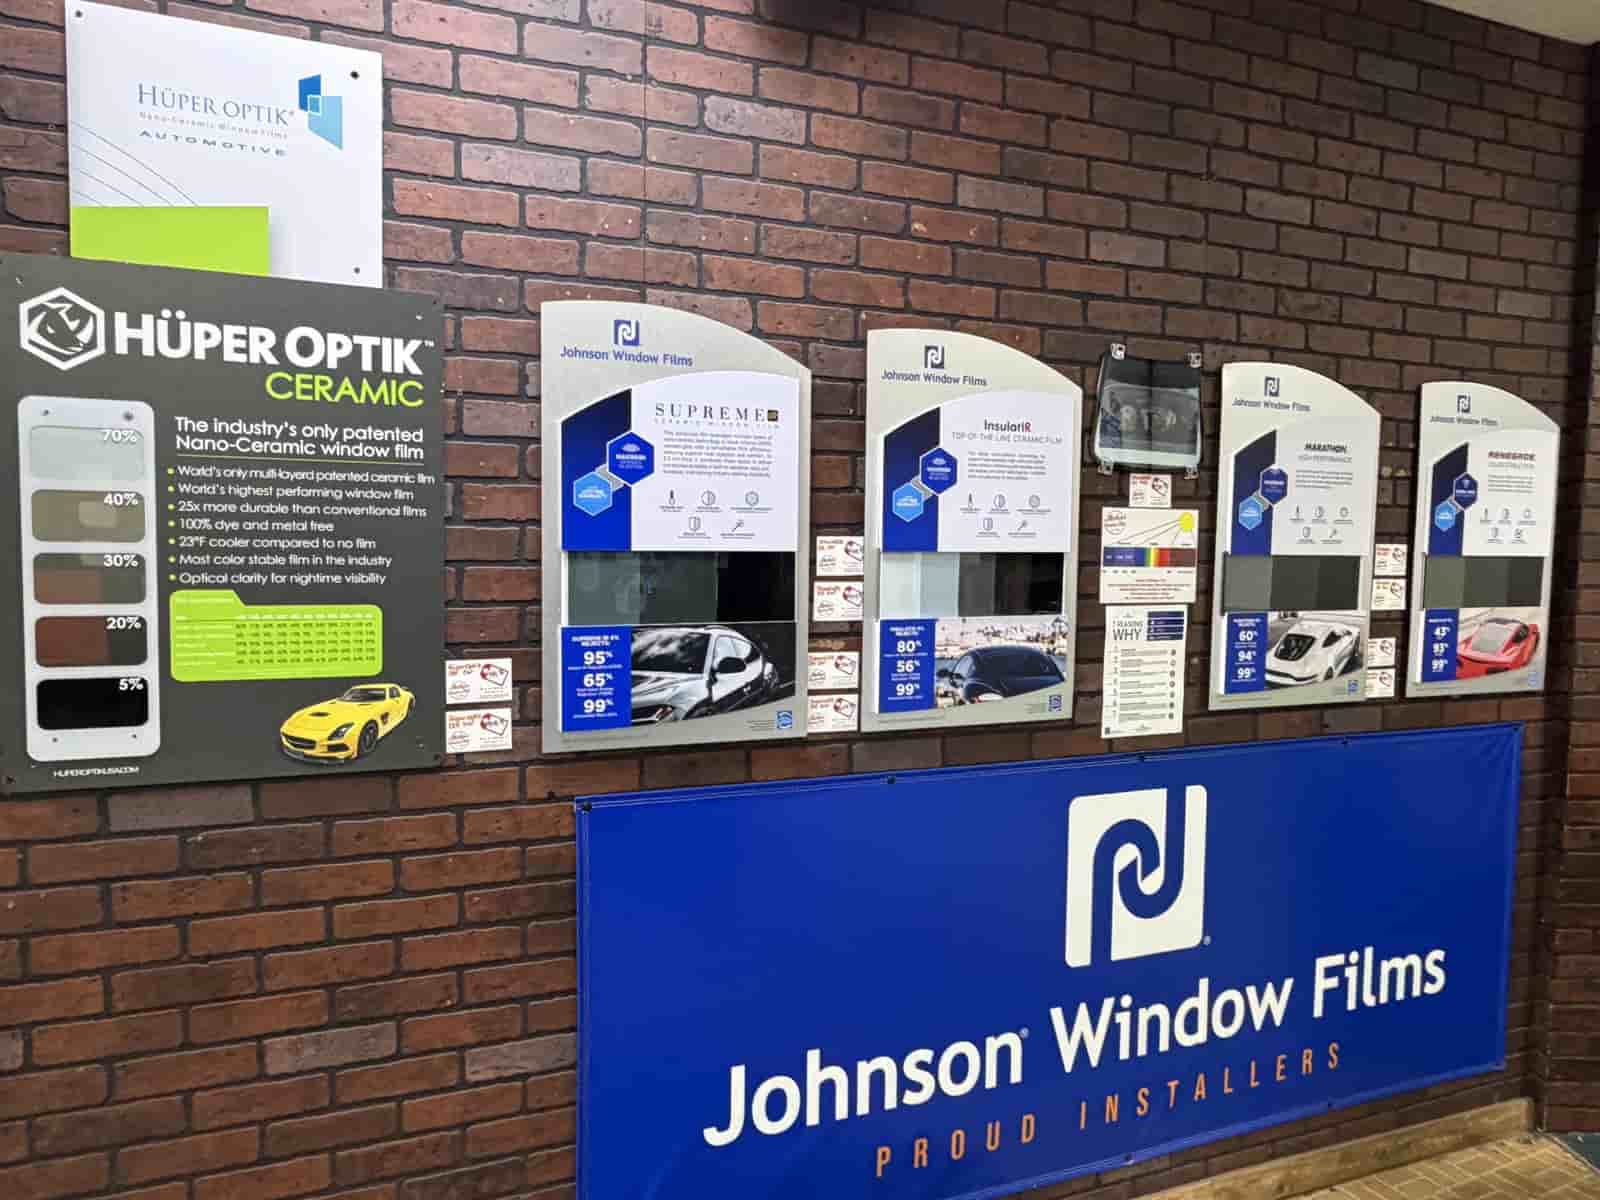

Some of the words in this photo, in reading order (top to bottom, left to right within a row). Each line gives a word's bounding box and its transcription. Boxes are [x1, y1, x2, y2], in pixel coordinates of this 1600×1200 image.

[139, 130, 286, 157] AUTOMOTIVE
[114, 309, 280, 365] HÜPER
[559, 345, 609, 362] Johnson
[613, 349, 659, 365] Window
[663, 354, 693, 368] Films
[881, 369, 920, 382] Johnson
[923, 372, 960, 385] Window
[962, 375, 988, 387] Films
[265, 372, 424, 408] CERAMIC
[655, 402, 765, 422] SUPREME
[103, 429, 137, 443] 70%
[175, 416, 209, 433] The
[213, 417, 298, 440] industry's
[302, 424, 338, 441] only
[343, 425, 424, 443] patented
[175, 434, 316, 455] Nano-Ceramic
[320, 441, 390, 458] window
[394, 443, 424, 460] film
[223, 468, 248, 480] only
[316, 470, 369, 483] patented
[103, 492, 139, 506] 40%
[178, 483, 226, 495] World's
[228, 484, 273, 498] highest
[275, 486, 343, 500] performing
[345, 488, 392, 500] window
[394, 488, 414, 501] film
[178, 500, 200, 512] 25x
[203, 503, 238, 513] more
[240, 503, 289, 514] durable
[292, 504, 321, 515] than
[323, 505, 401, 517] conventional
[402, 505, 428, 518] films
[180, 518, 213, 530] 100%
[214, 520, 240, 532] dye
[242, 520, 269, 530] and
[271, 520, 308, 531] metal
[310, 520, 335, 532] free
[208, 537, 250, 548] cooler
[252, 538, 320, 551] compared
[322, 538, 336, 549] to
[337, 540, 354, 549] no
[355, 538, 377, 549] film
[103, 554, 139, 568] 30%
[179, 554, 210, 565] Most
[214, 554, 245, 565] color
[248, 554, 287, 566] stable
[288, 554, 310, 566] film
[311, 555, 323, 566] in
[325, 555, 346, 566] the
[347, 555, 393, 568] industry
[179, 572, 229, 585] Optical
[230, 572, 269, 585] clarity
[271, 572, 287, 583] for
[106, 616, 142, 630] 20%
[1113, 628, 1142, 640] WHY
[119, 677, 145, 691] 5%
[703, 1030, 1024, 1147] Johnson
[1050, 977, 1294, 1073] Window
[1313, 946, 1446, 1018] Films
[876, 1113, 1036, 1178] PROUD
[1079, 1041, 1340, 1130] INSTALLERS
